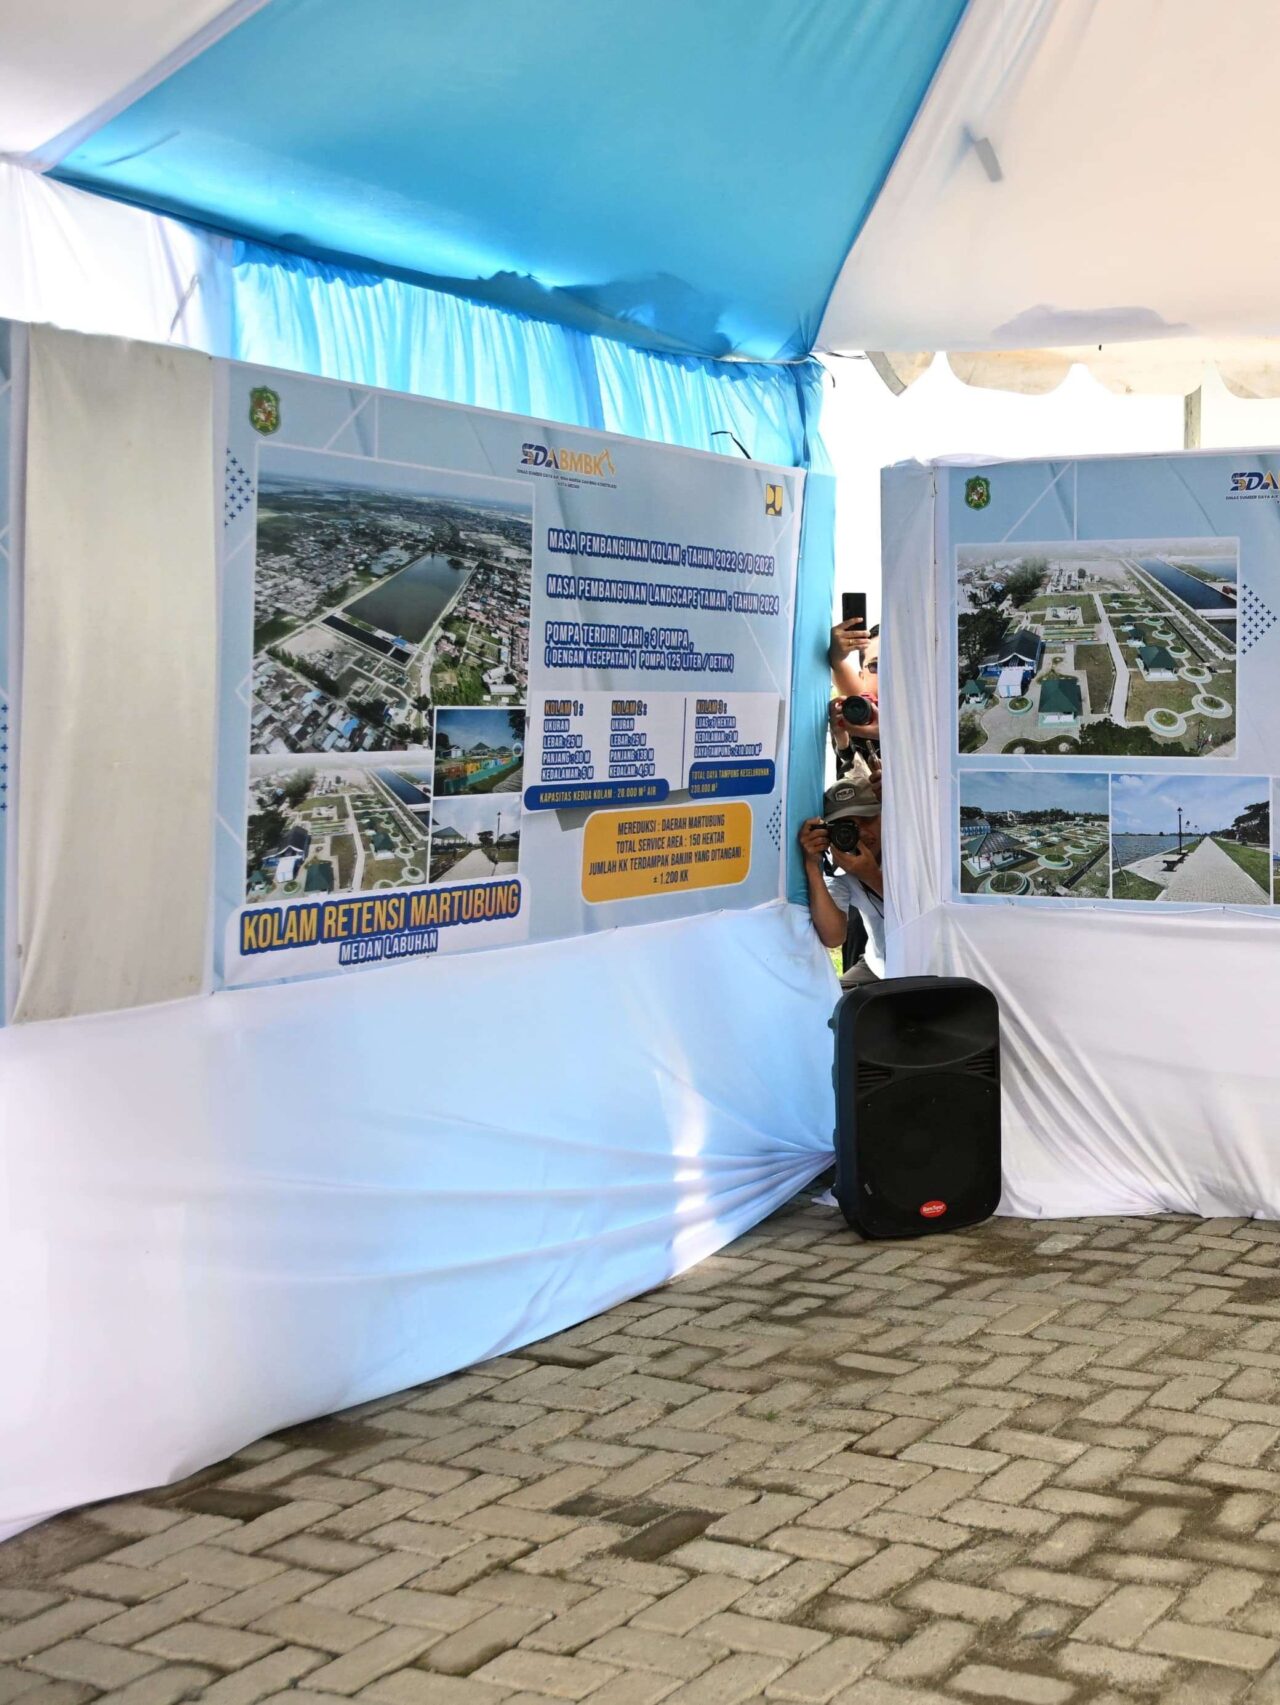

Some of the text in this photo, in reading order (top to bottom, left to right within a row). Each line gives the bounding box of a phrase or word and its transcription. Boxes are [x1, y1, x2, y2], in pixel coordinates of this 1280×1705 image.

[548, 529, 774, 575] MASA PEMBANGUNAN KOLAM TAHUN 2022 S/D 2023
[547, 575, 779, 615] MASA PEMBANGUNAN LANDSCAPE TAMAN TAHUN 2024
[545, 622, 579, 643] POMPA
[582, 624, 619, 645] TERDIRI
[622, 626, 643, 647] DARI
[650, 627, 657, 647] 3
[551, 647, 584, 666] DENGAN
[586, 648, 629, 667] KECEPATAN
[630, 650, 636, 667] 1
[640, 650, 665, 669] POMPA
[667, 652, 681, 670] 125
[682, 653, 701, 671] LITER
[545, 700, 571, 716] KOLAM
[611, 700, 636, 716] KOLAM
[696, 700, 717, 714] KOLAM
[544, 719, 570, 732] UKURAN
[611, 718, 635, 731] UKURAN
[542, 752, 570, 765] PANJANG
[539, 791, 572, 803] KAPASITAS
[573, 790, 592, 801] KEDUA
[593, 789, 613, 800] KOLAM
[647, 786, 657, 796] AIR
[617, 814, 725, 836] MEREDUKSI DAERAH MARTUBUNG
[616, 832, 725, 854] TOTAL SERVICE AREA 150 HEKTAR
[588, 847, 741, 876] JUMLAH KK TERDAMPAK BANJIR YANG DITANGANI
[659, 870, 679, 885] 1.200
[680, 869, 689, 882] KK
[242, 882, 520, 951] KOLAM RETENSI MARTUBUNG
[340, 932, 437, 961] MEDAN LABUHAN
